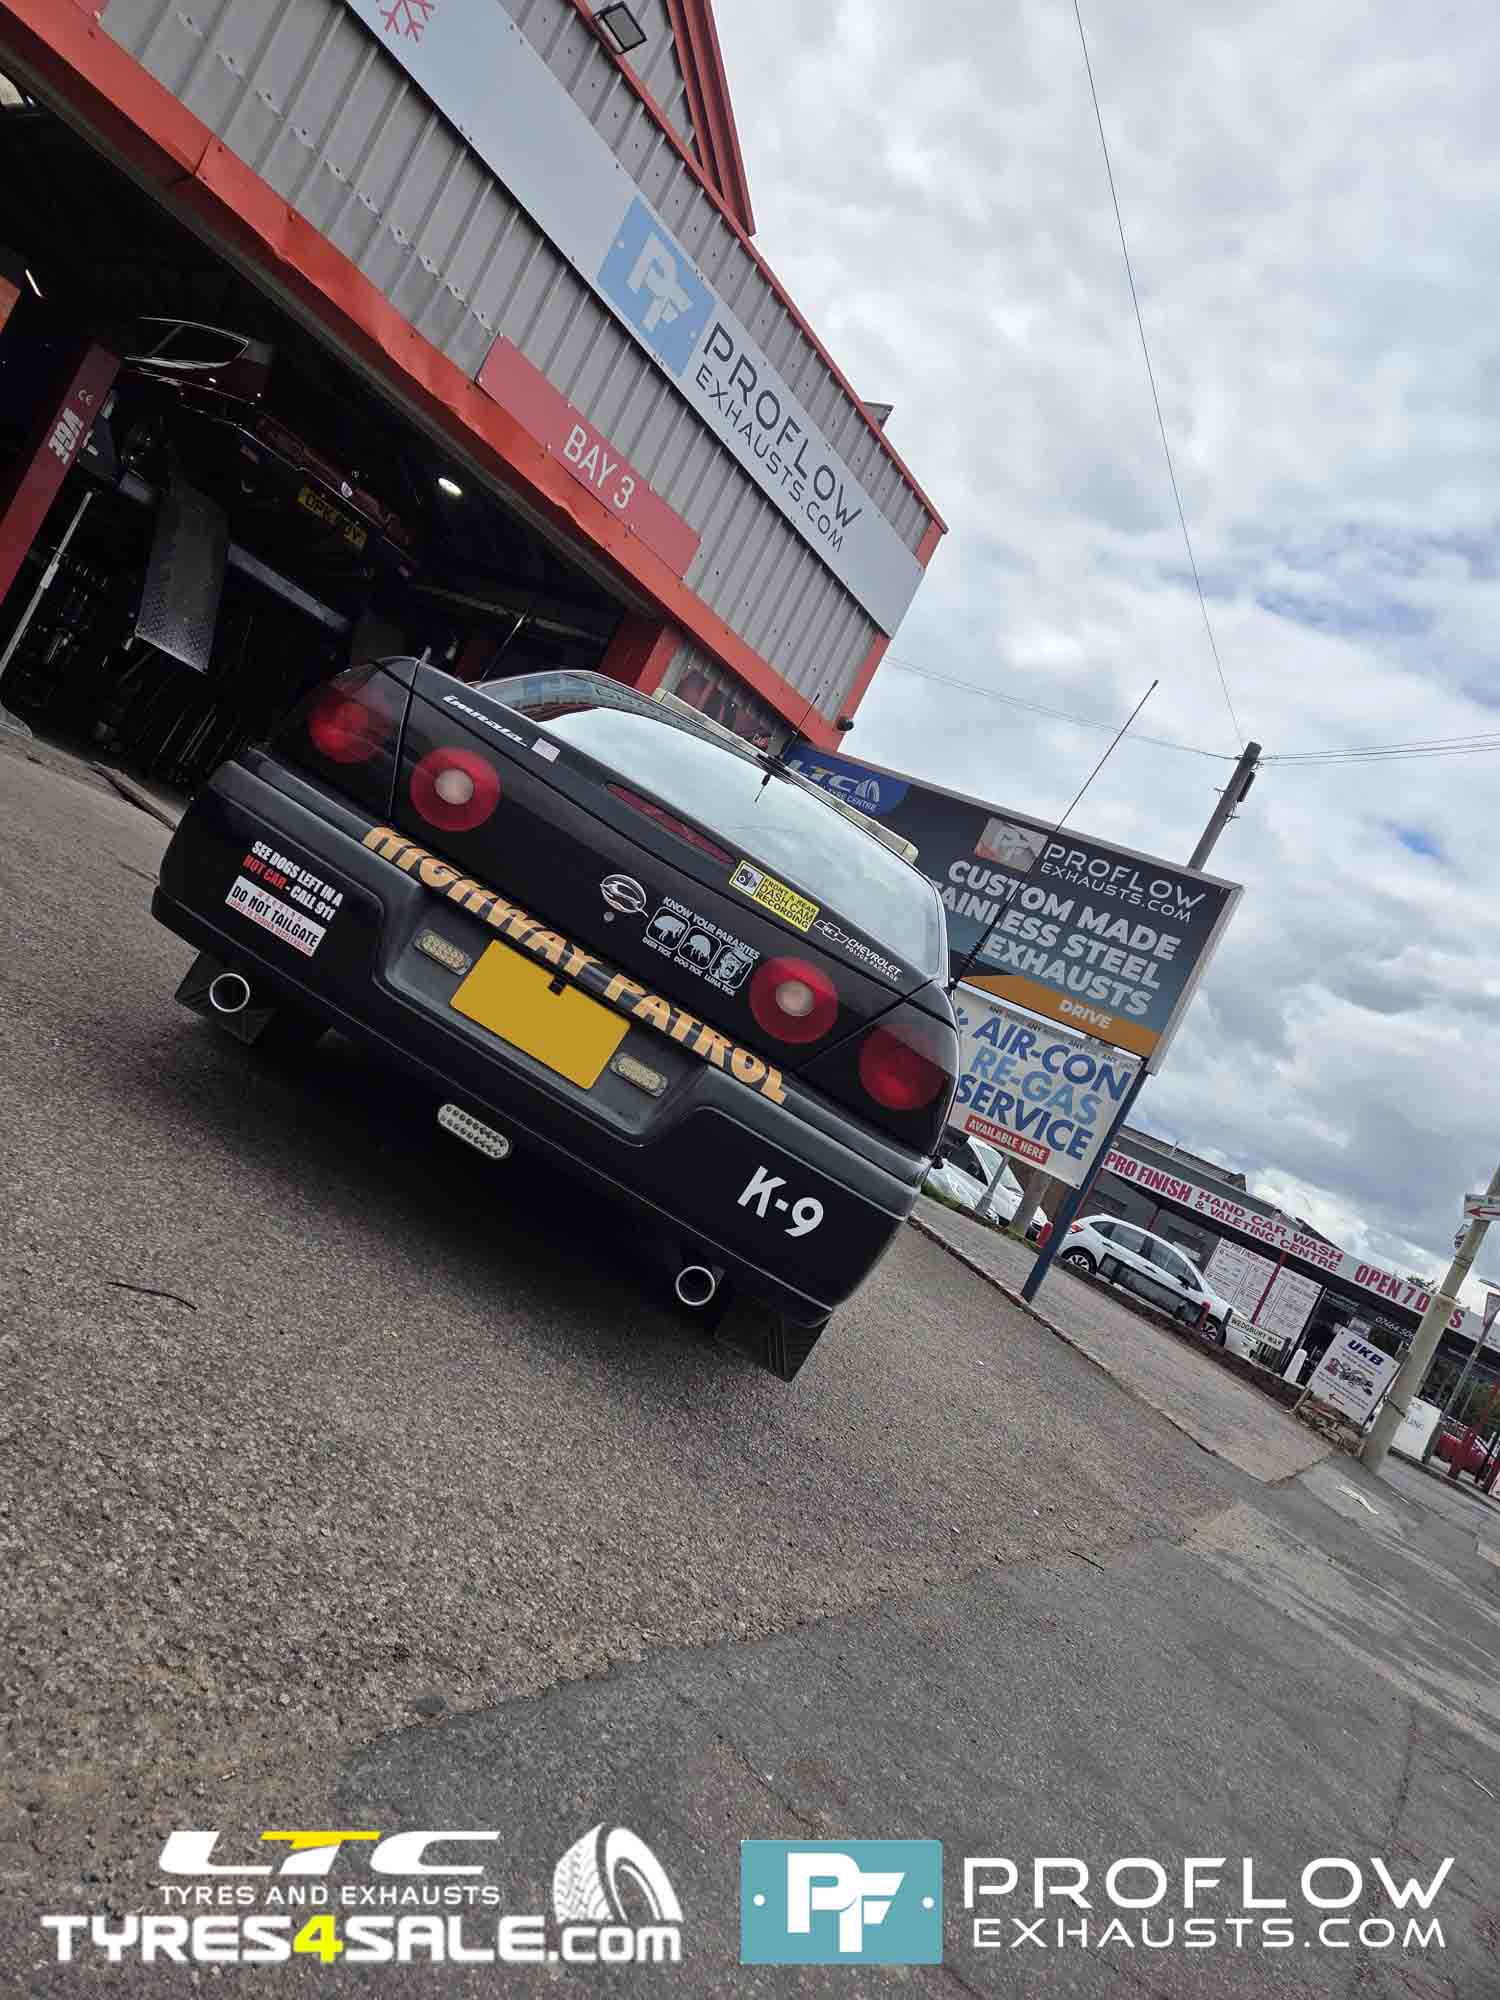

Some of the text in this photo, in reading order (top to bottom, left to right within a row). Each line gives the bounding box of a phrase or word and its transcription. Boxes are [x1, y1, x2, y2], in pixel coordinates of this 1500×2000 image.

[703, 321, 863, 529] PROFLOW
[563, 423, 635, 509] BAY 3
[695, 363, 844, 553] EXHAUSTS.COM
[847, 795, 877, 812] CENTRE
[242, 854, 266, 875] HOT
[263, 868, 288, 890] CAR
[290, 885, 317, 910] CALL
[314, 901, 336, 921] 911
[252, 840, 344, 907] SEE DOGS LEFT IN A
[760, 883, 814, 920] DASH CAM
[1040, 861, 1191, 922] EXHAUSTS.COM
[1043, 843, 1206, 909] PROFLOW
[232, 886, 319, 947] DO NOT TAILGATE
[663, 896, 760, 960] KNOW YOUR PARASITES
[757, 892, 809, 929] RECORDING
[949, 860, 1182, 962] CUSTOM MADE
[362, 826, 604, 977] HIGHWAY
[604, 973, 786, 1104] PATROL
[657, 946, 672, 958] TICK
[673, 956, 703, 977] DOG TICK
[847, 938, 903, 975] CHEVROLET
[983, 933, 1153, 1017] EXHAUSTS
[1063, 933, 1160, 991] STEEL
[721, 985, 736, 997] TICK
[1058, 999, 1113, 1029] DRIVE
[970, 1045, 1102, 1126] RE-GAS
[973, 1017, 1131, 1101] AIR-CON
[956, 1073, 1094, 1160] SERVICE
[968, 1119, 1046, 1160] AVAILABLE HERE
[737, 1165, 824, 1237] K-9
[1103, 1151, 1193, 1202] PRO FINISH
[1194, 1200, 1205, 1211] &
[1210, 1205, 1275, 1242] VALETING
[1279, 1239, 1339, 1272] CENTRE
[1198, 1190, 1246, 1217] HAND
[1251, 1215, 1288, 1237] CAR
[1292, 1233, 1344, 1262] WASH
[1354, 1264, 1403, 1299] OPEN
[1402, 1286, 1416, 1304] 7
[1347, 1339, 1384, 1366] UKB
